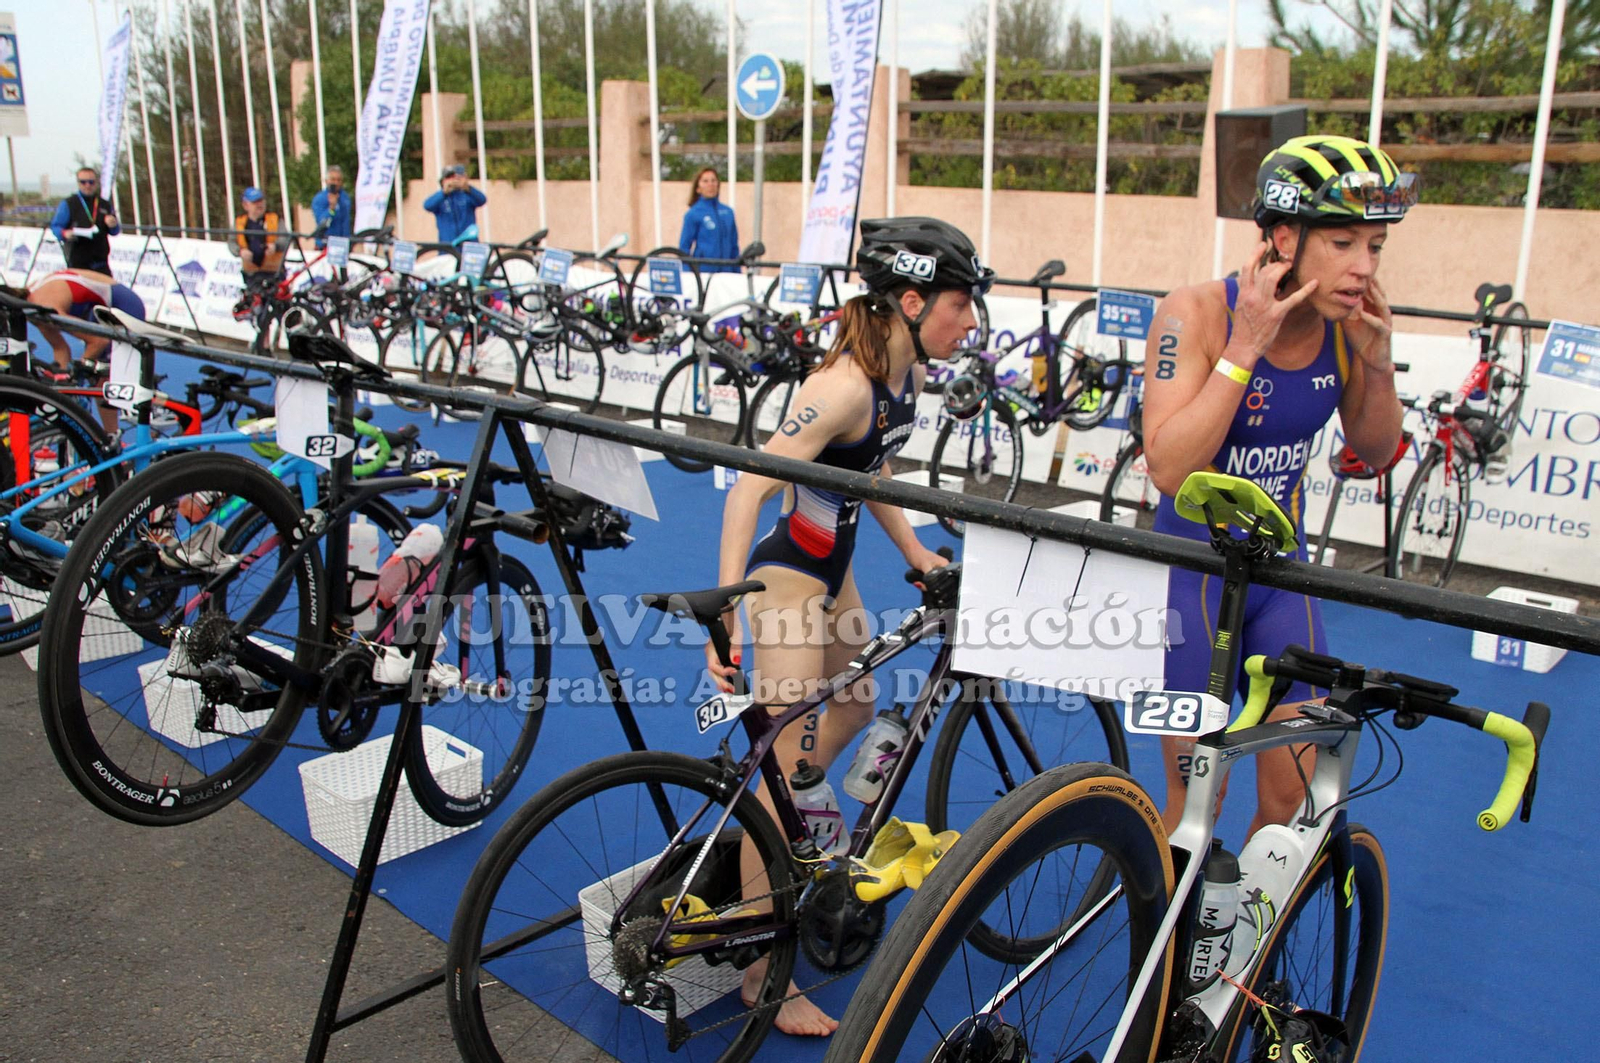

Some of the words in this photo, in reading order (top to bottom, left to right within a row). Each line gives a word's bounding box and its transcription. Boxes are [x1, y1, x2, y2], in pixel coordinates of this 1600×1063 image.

[1265, 184, 1294, 209] 28
[898, 254, 933, 277] 30
[1102, 303, 1120, 321] 35
[1155, 334, 1178, 380] 28
[1549, 338, 1577, 360] 31
[107, 385, 133, 400] 34
[1312, 374, 1335, 390] TYR
[308, 437, 335, 456] 32
[1467, 499, 1592, 539] Deportes
[1500, 638, 1521, 658] 31
[700, 703, 723, 729] 30
[1138, 695, 1199, 730] 28
[92, 760, 155, 804] BONTRAGER
[1087, 784, 1139, 802] SCHWALBE
